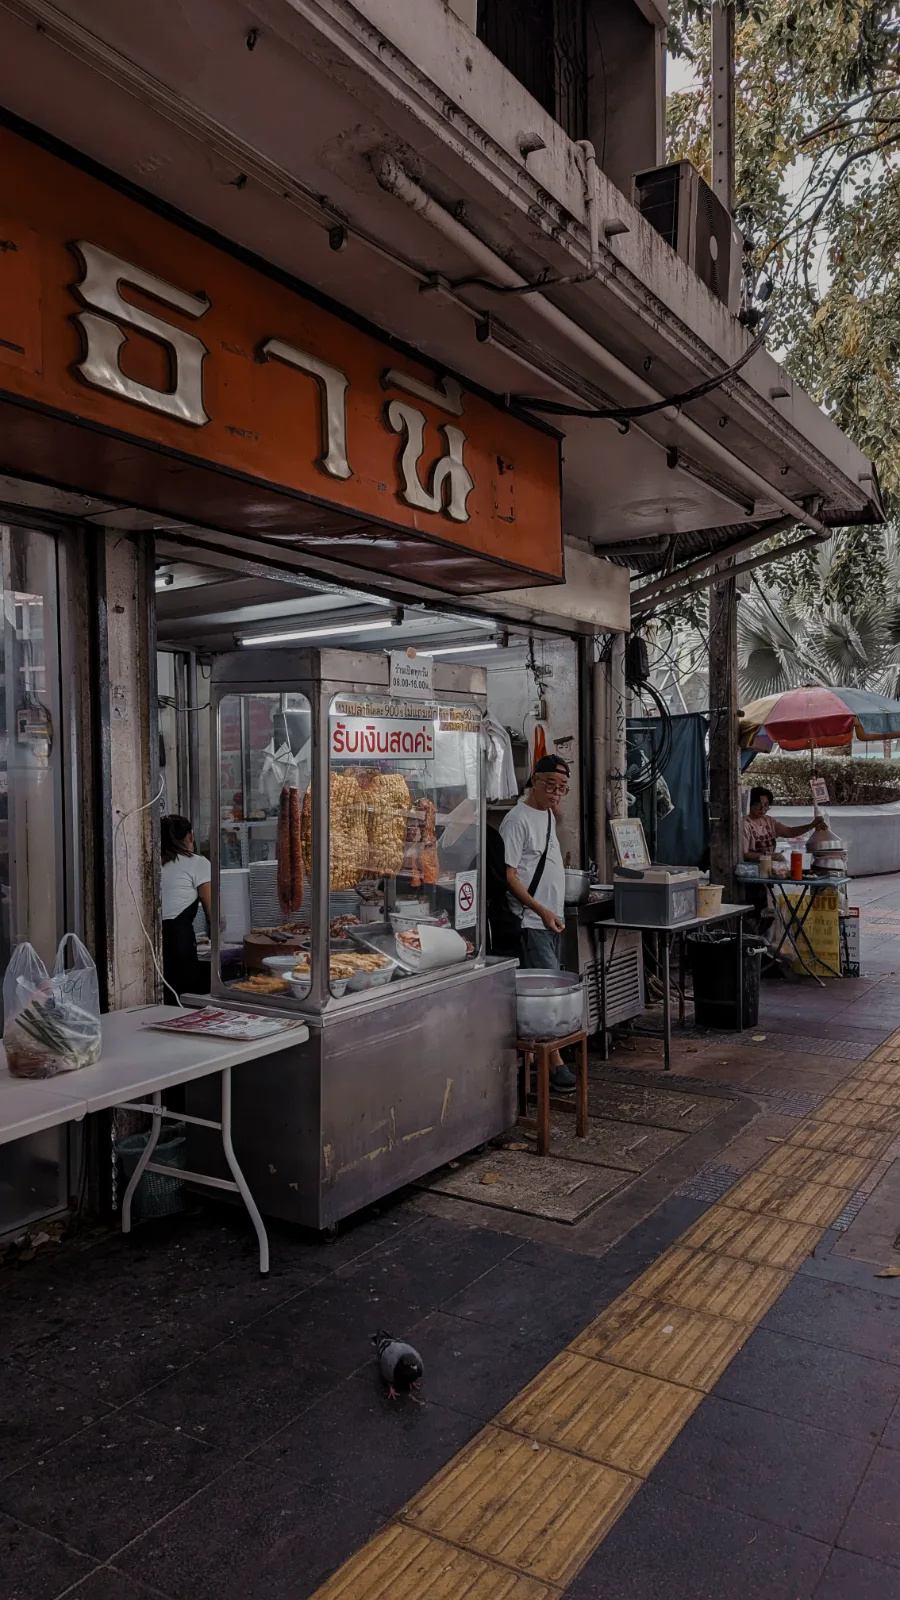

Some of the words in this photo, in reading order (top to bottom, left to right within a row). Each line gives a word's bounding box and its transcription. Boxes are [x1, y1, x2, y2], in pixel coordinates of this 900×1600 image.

[332, 721, 433, 753] รับเงินสดค่ะ
